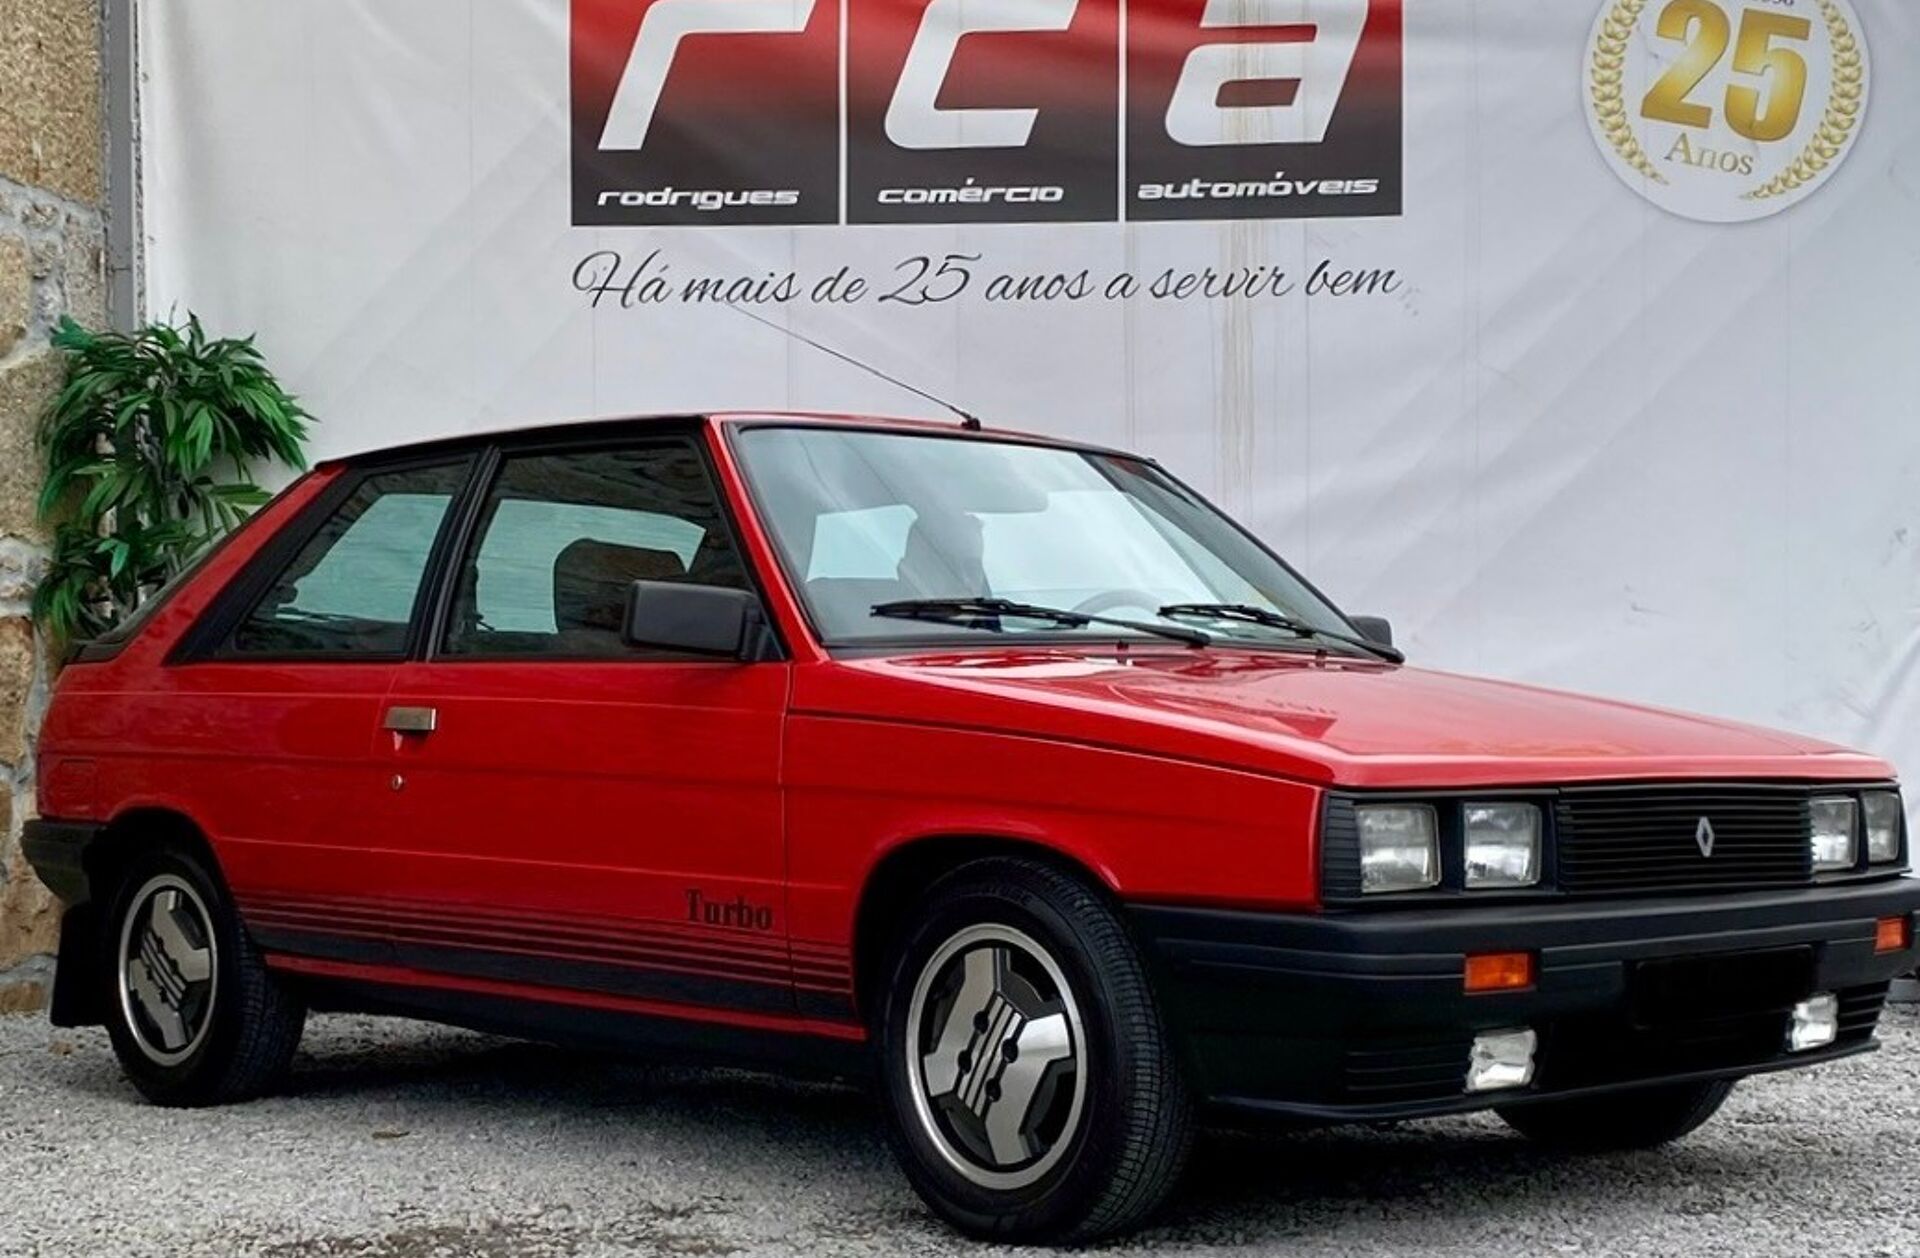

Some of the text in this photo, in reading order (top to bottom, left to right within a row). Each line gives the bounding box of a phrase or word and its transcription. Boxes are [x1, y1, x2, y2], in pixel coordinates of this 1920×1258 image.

[1640, 0, 1811, 142] 25
[1663, 132, 1754, 176] Anos
[598, 172, 1380, 210] rodrigues comércio automóveis
[572, 249, 1404, 309] Há mais de 25 anos a servir bem
[685, 888, 773, 930] Turbo
